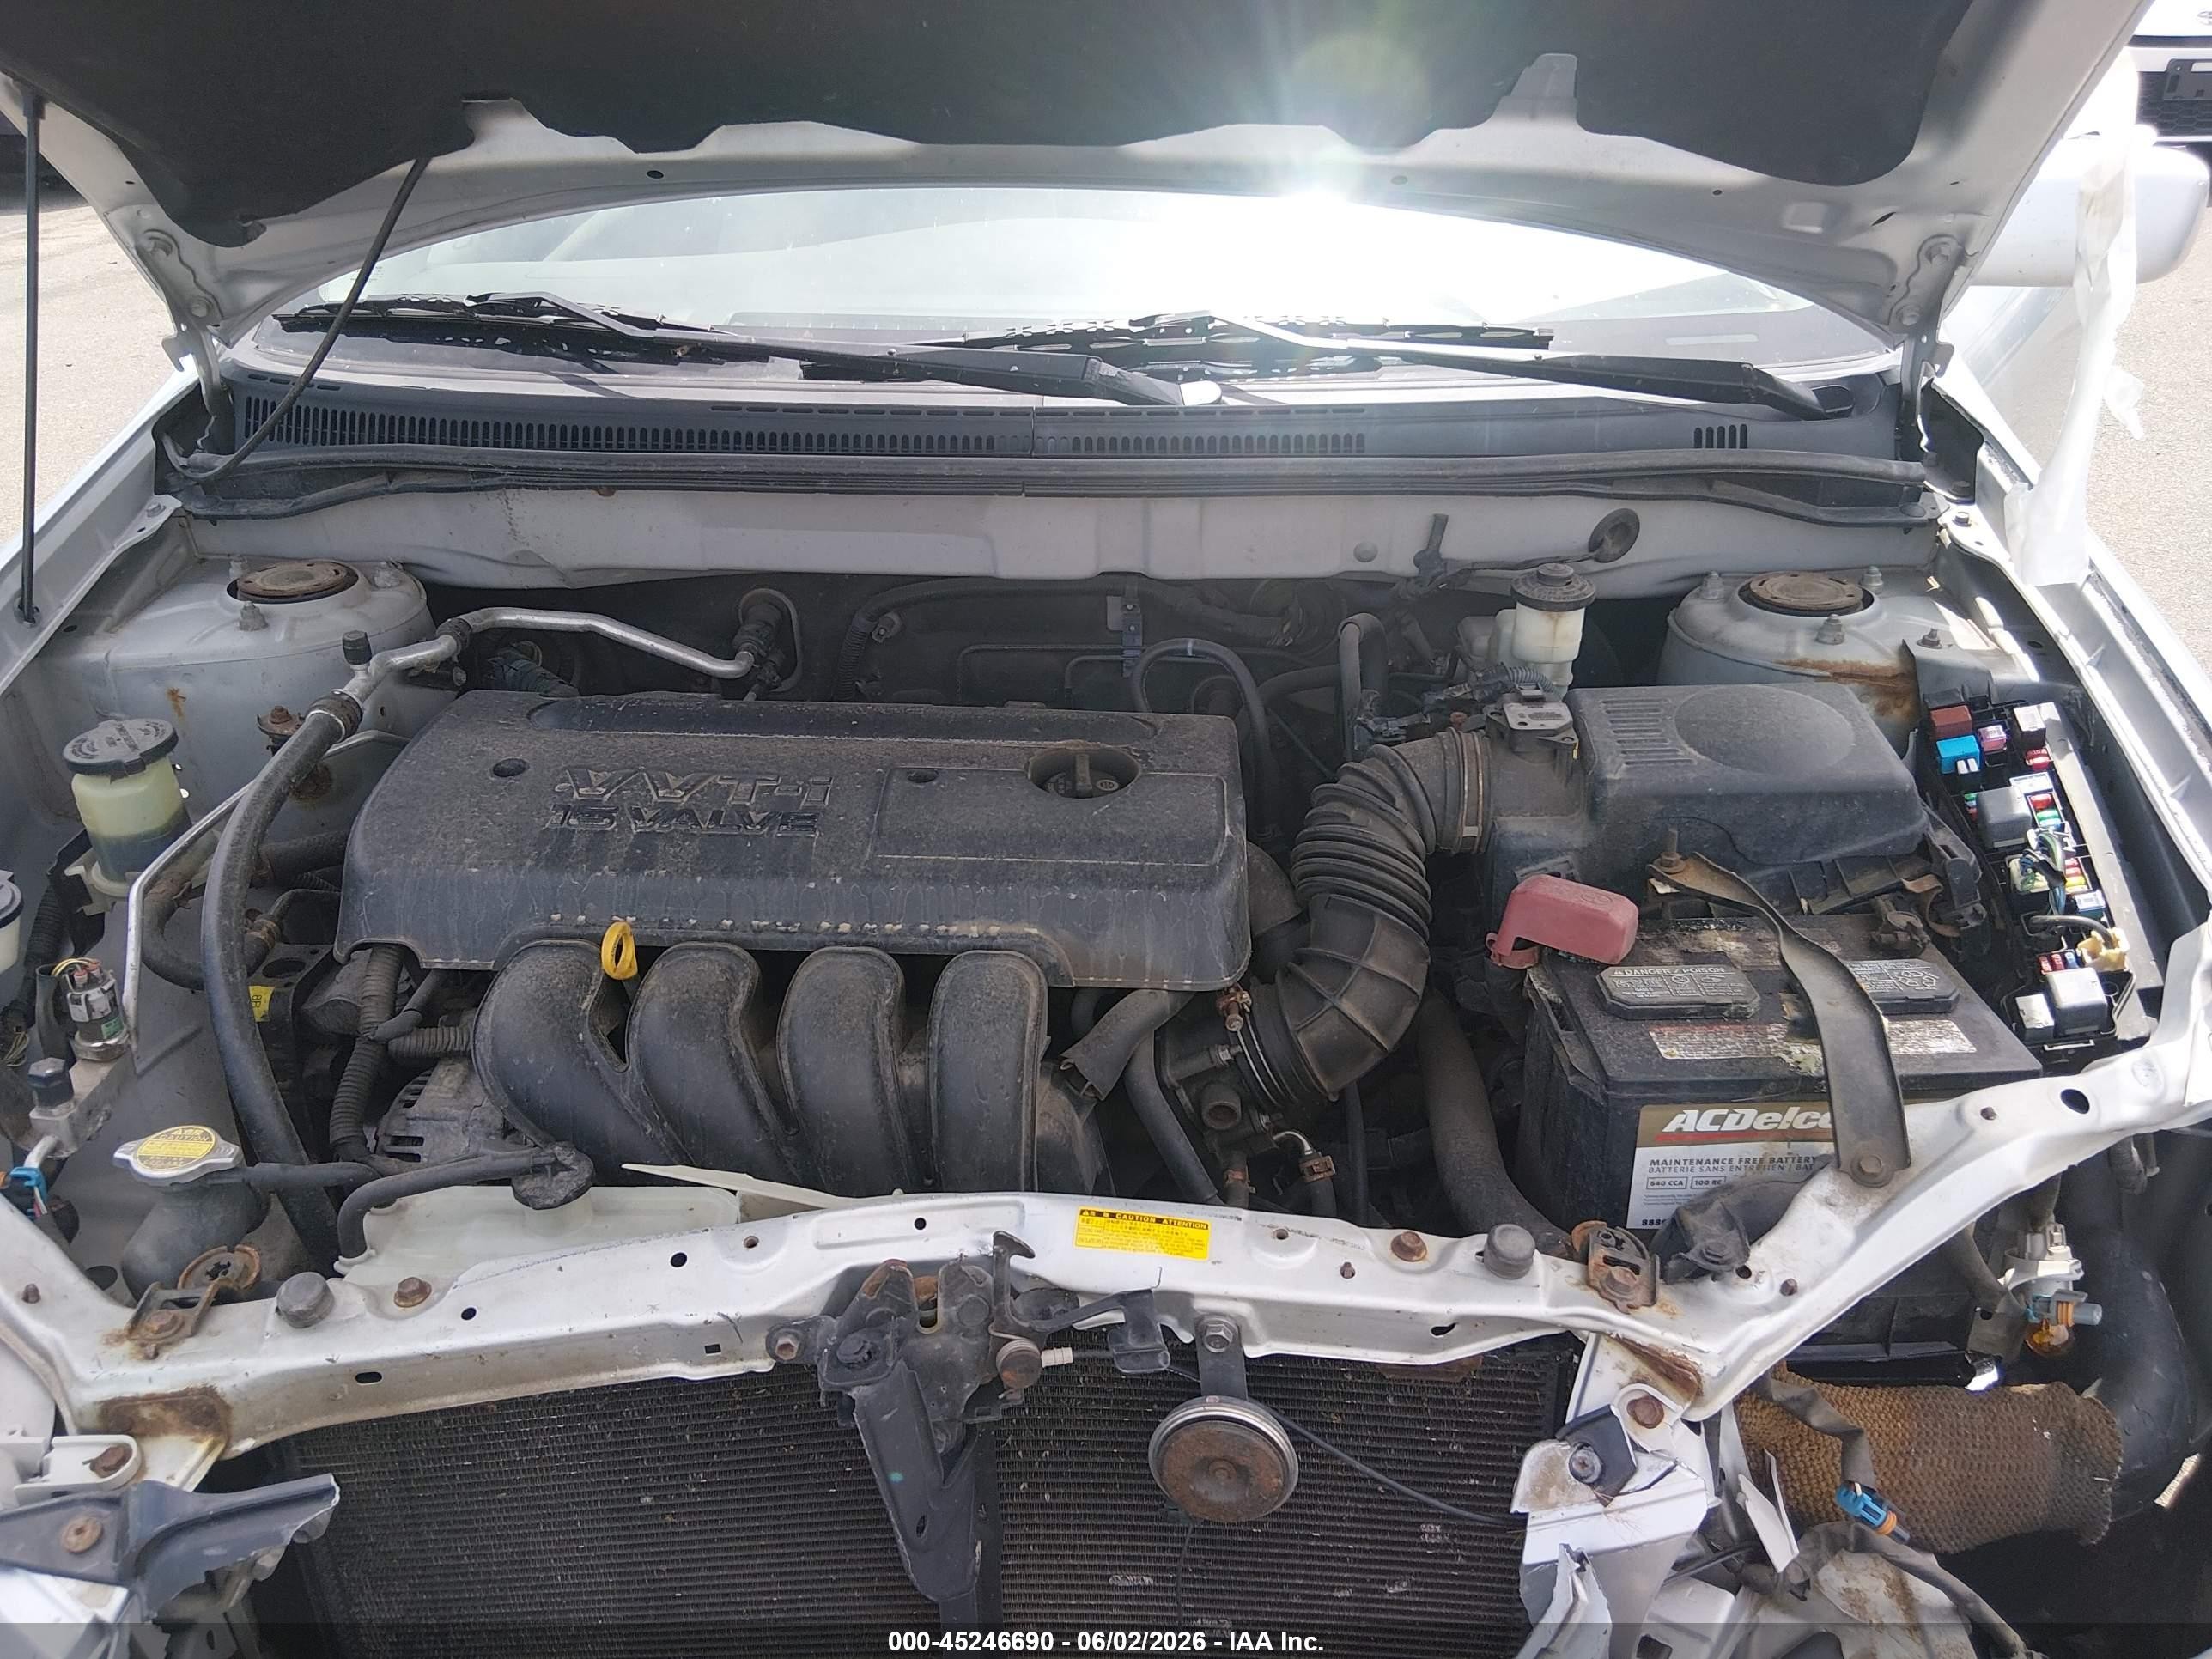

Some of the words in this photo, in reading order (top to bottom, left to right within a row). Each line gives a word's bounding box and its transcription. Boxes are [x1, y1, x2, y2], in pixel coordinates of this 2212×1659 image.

[625, 805, 820, 836] VALVE
[159, 1133, 210, 1142] CAUTION
[1650, 1157, 1735, 1166] MAINTENANCE
[1115, 1212, 1156, 1224] CAUTION
[1162, 1218, 1206, 1230] ATTENTION
